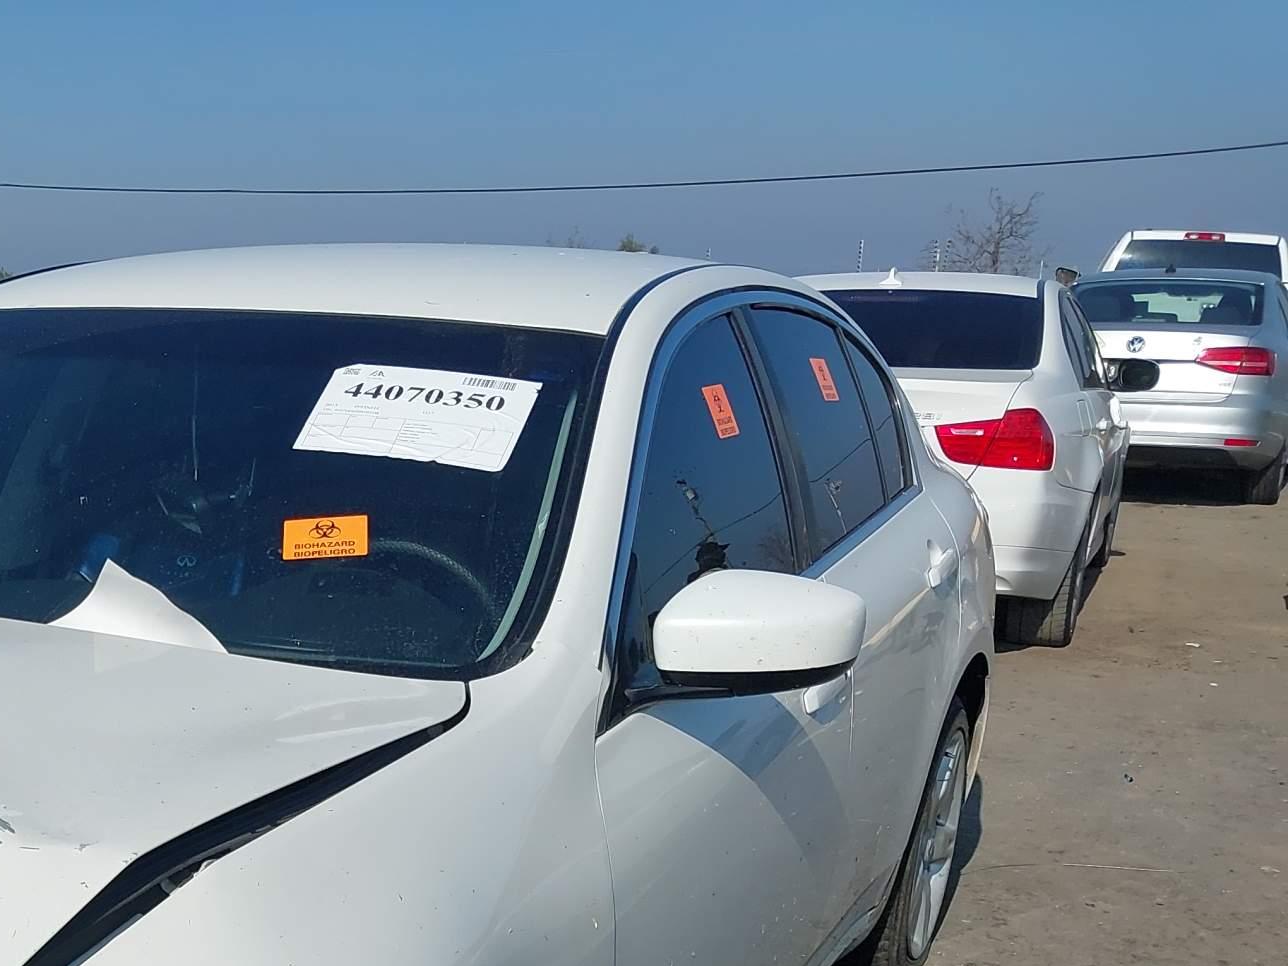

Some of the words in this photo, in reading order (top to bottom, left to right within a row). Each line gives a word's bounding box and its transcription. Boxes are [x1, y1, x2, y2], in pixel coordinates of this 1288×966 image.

[344, 382, 505, 412] 44070350
[294, 540, 356, 550] BIOHAZARD
[294, 548, 356, 558] BIOPELIGRO
